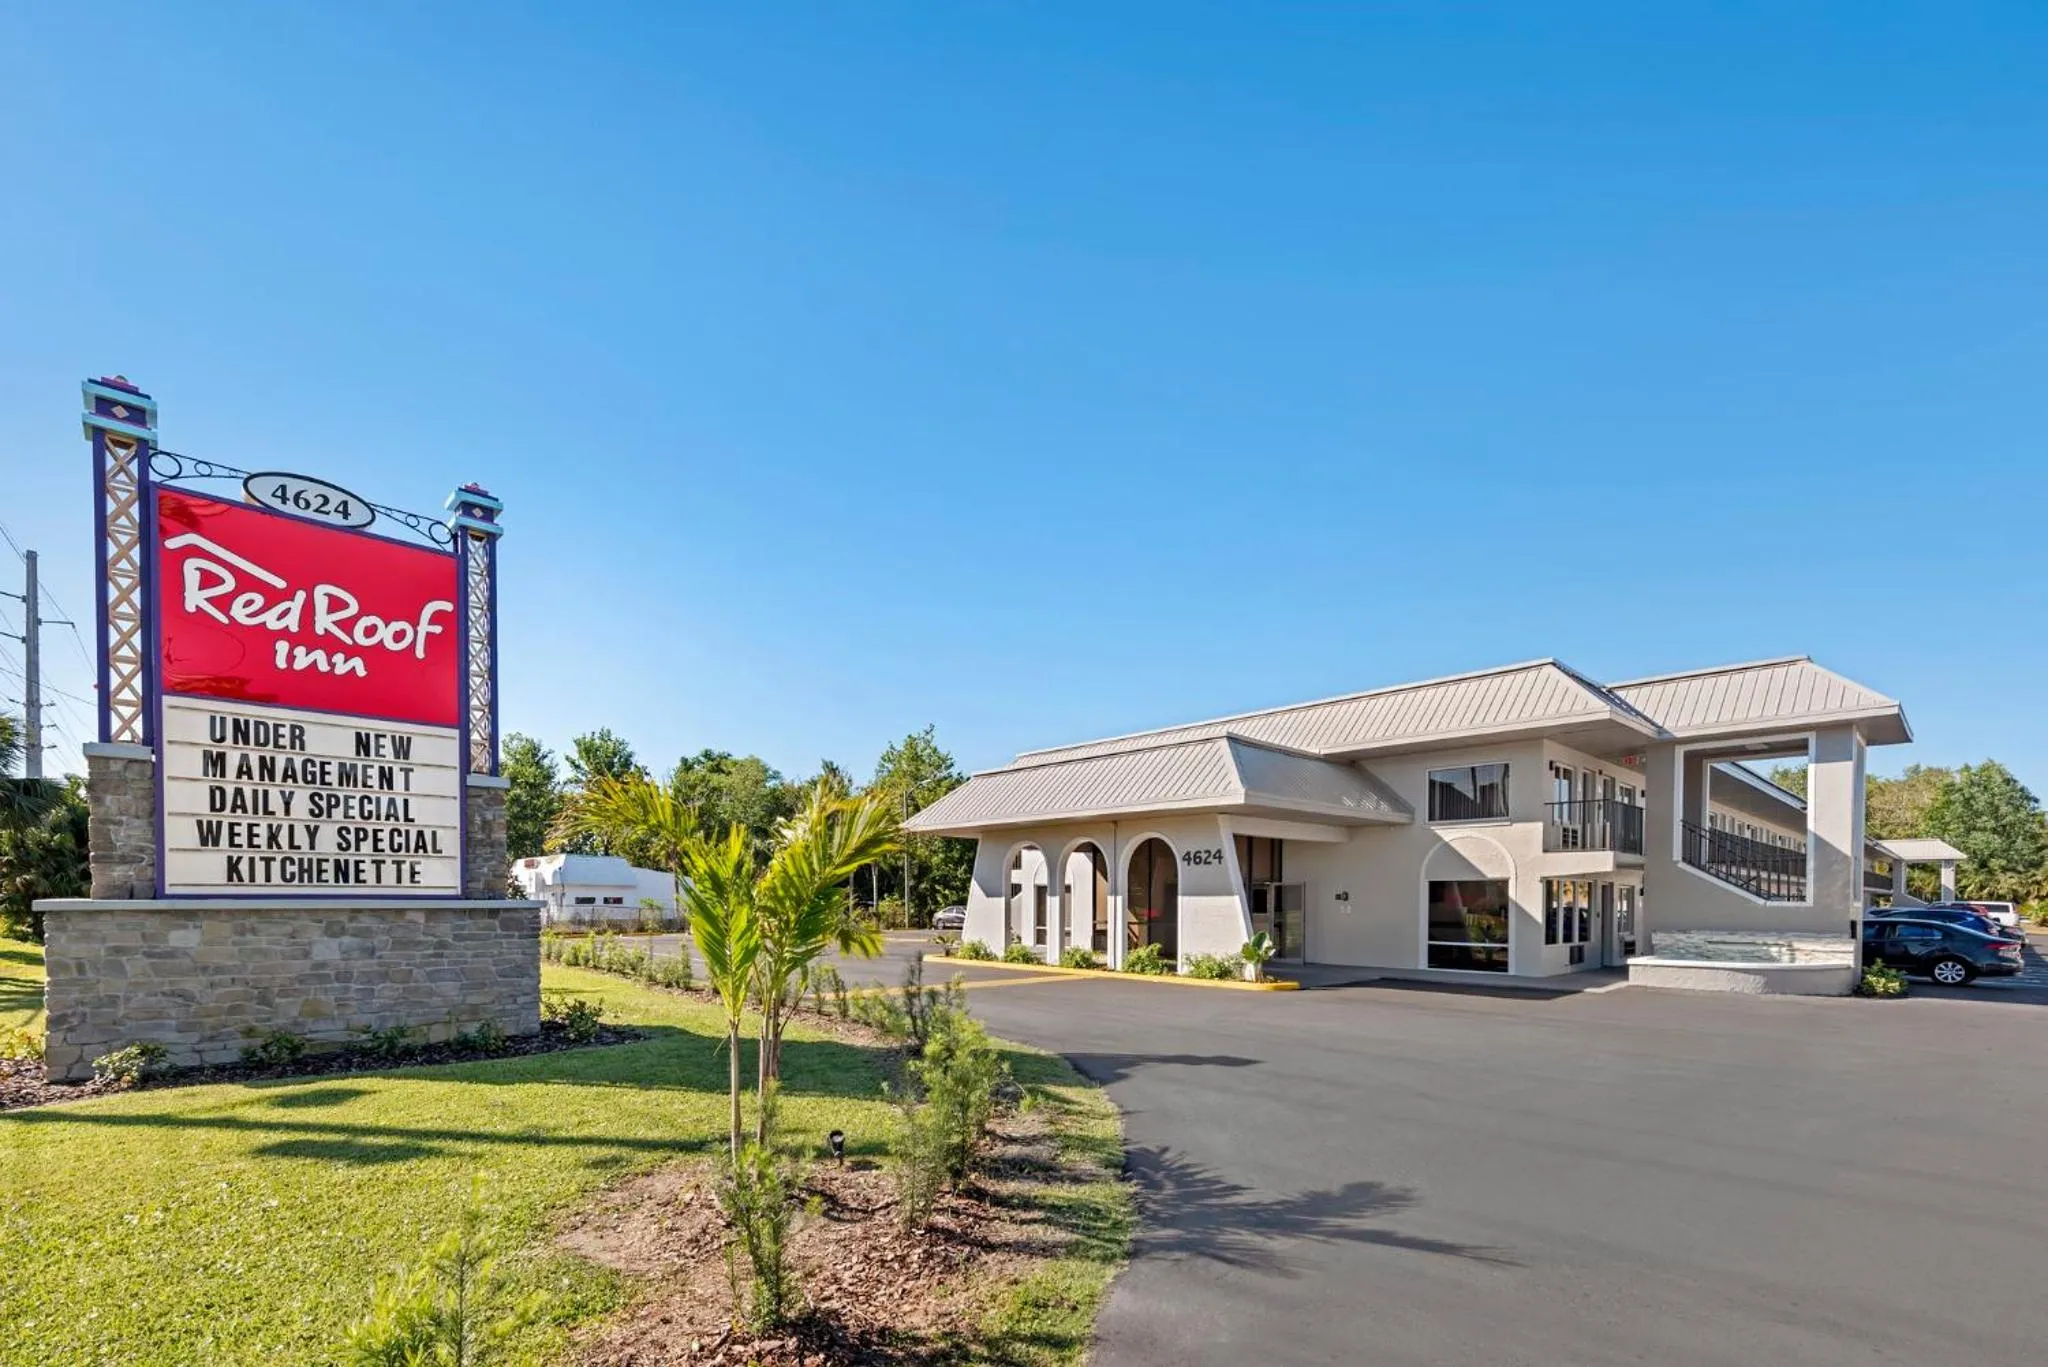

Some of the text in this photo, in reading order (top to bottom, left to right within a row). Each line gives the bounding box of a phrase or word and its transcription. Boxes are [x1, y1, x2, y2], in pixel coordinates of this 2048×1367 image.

[271, 483, 352, 521] 4624
[209, 715, 412, 760] UNDER NEW
[202, 749, 414, 792] MANAGEMENT
[209, 785, 415, 823] DAILY SPECIAL
[196, 819, 443, 855] WEEKLY SPECIAL
[226, 855, 421, 885] KITCHENETTE
[1182, 848, 1223, 867] 4624
